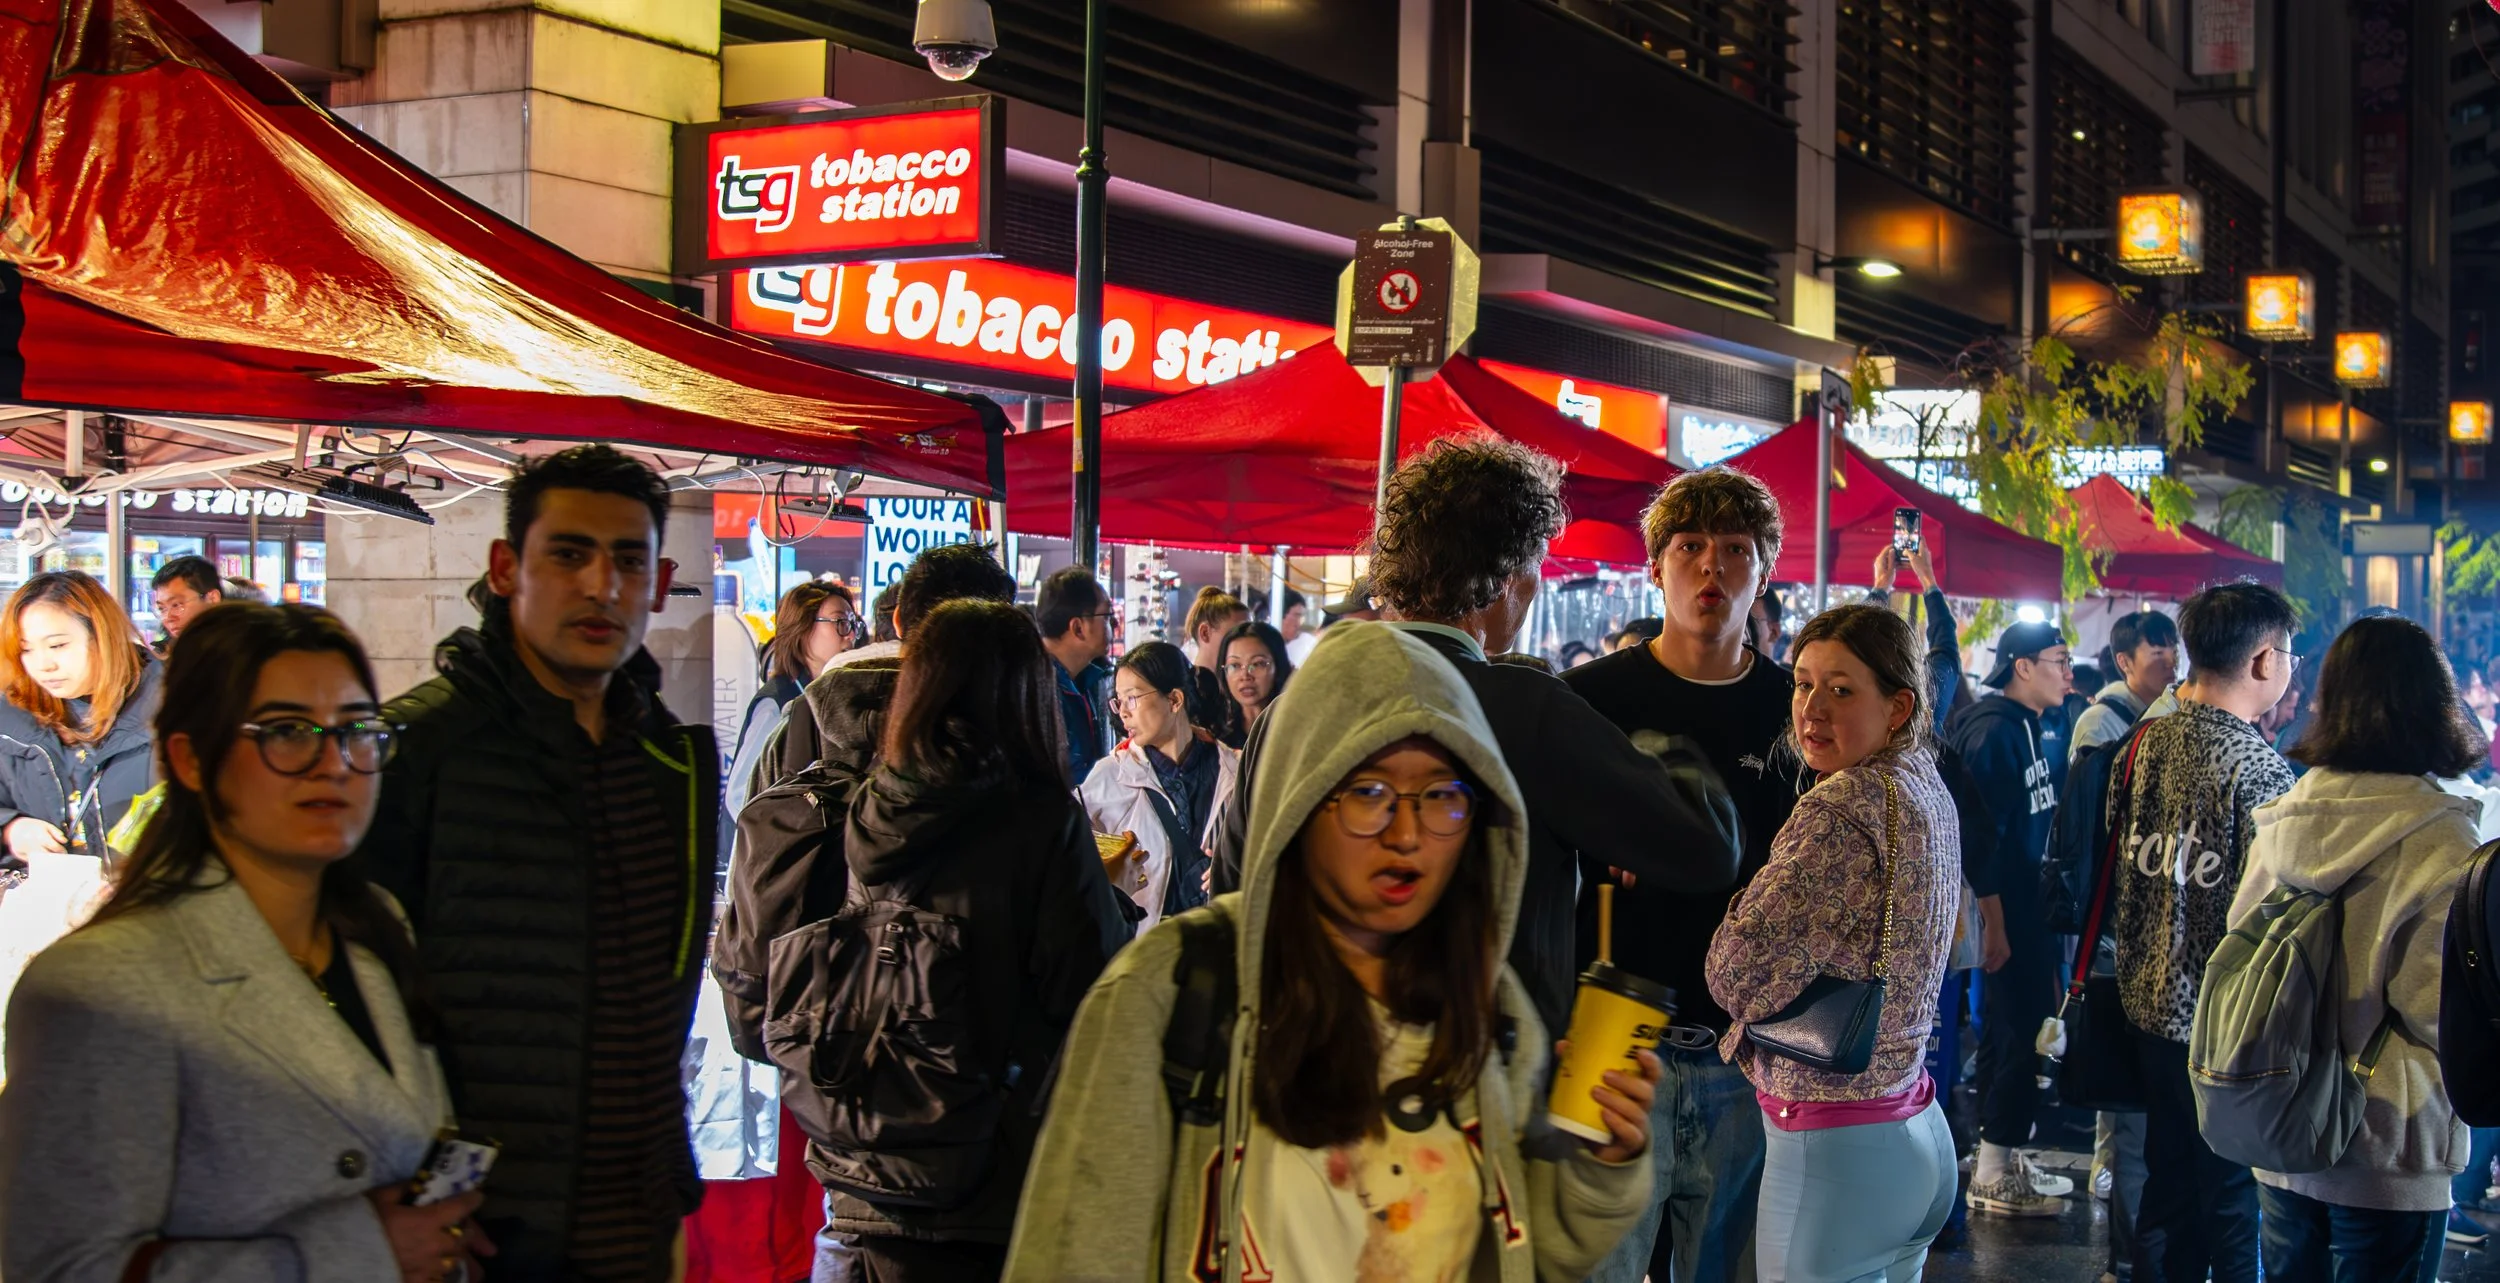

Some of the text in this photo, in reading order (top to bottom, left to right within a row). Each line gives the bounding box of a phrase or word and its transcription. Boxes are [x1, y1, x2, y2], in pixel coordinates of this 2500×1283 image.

[810, 148, 971, 188] tobacco
[716, 155, 800, 233] tsg
[819, 182, 961, 223] station
[1373, 239, 1434, 249] Alcohol-Free
[1390, 249, 1415, 258] Zone
[1152, 320, 1297, 385] stati
[877, 498, 970, 523] YOUR A
[873, 561, 906, 587] LO
